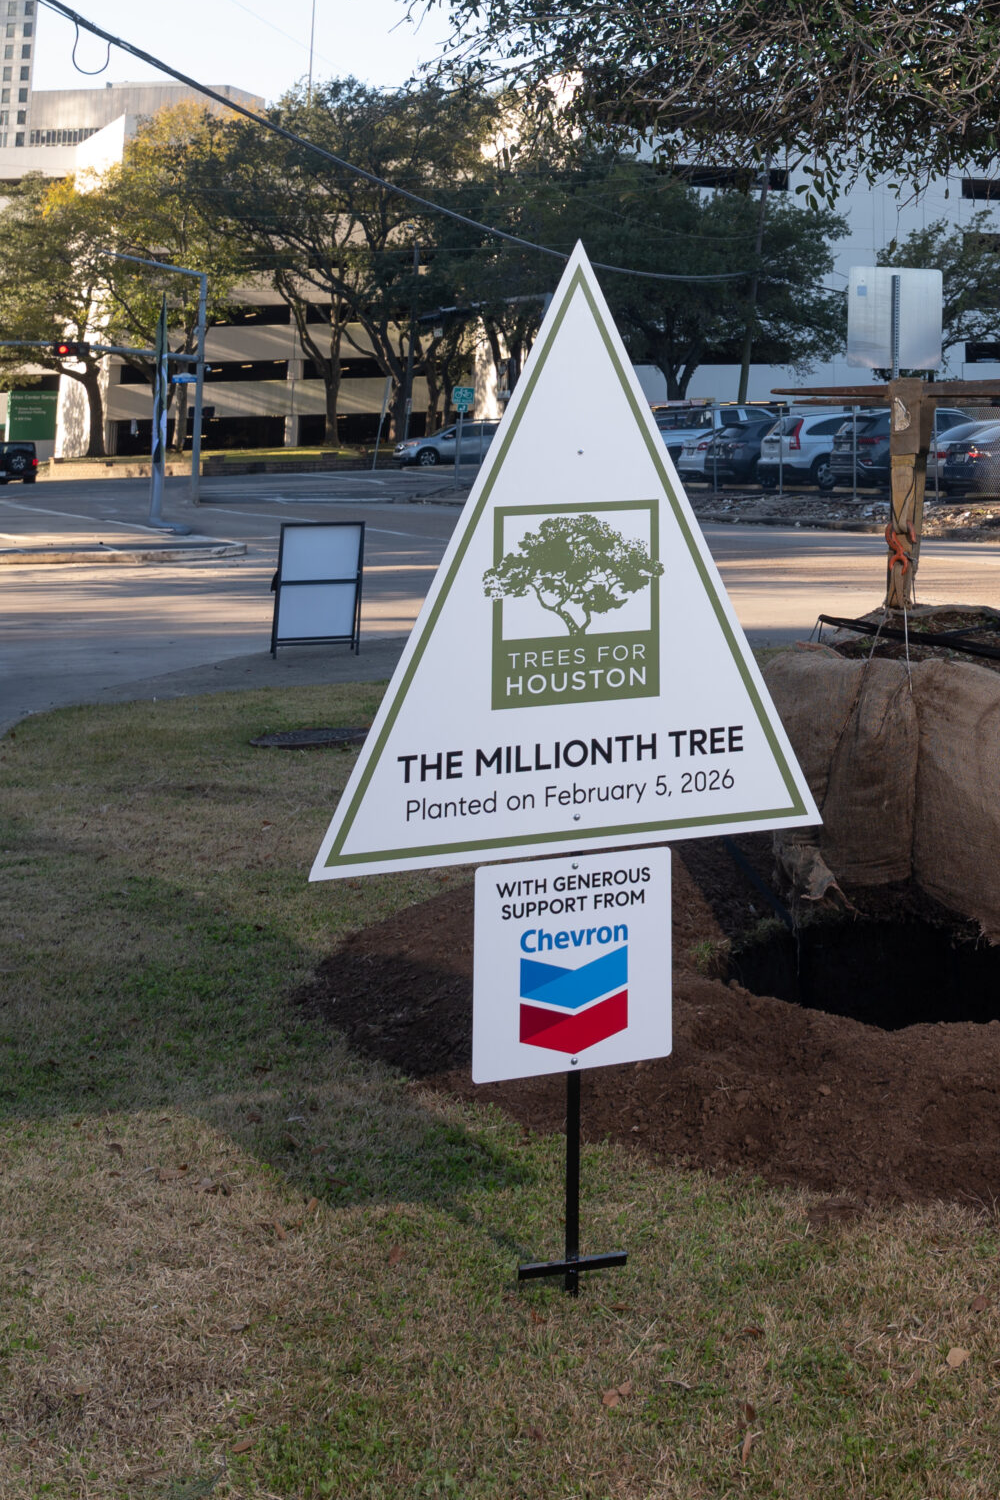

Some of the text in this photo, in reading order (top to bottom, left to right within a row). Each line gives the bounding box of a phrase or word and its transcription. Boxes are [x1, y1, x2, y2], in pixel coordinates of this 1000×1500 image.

[508, 644, 645, 668] TREES FOR
[507, 666, 646, 696] HOUSTON
[398, 726, 743, 783] THE MILLIONTH TREE
[407, 769, 734, 821] Planted on February 5, 2026
[496, 867, 650, 898] WITH GENEROUS
[501, 889, 644, 920] SUPPORT FROM
[520, 924, 628, 953] Chevron
